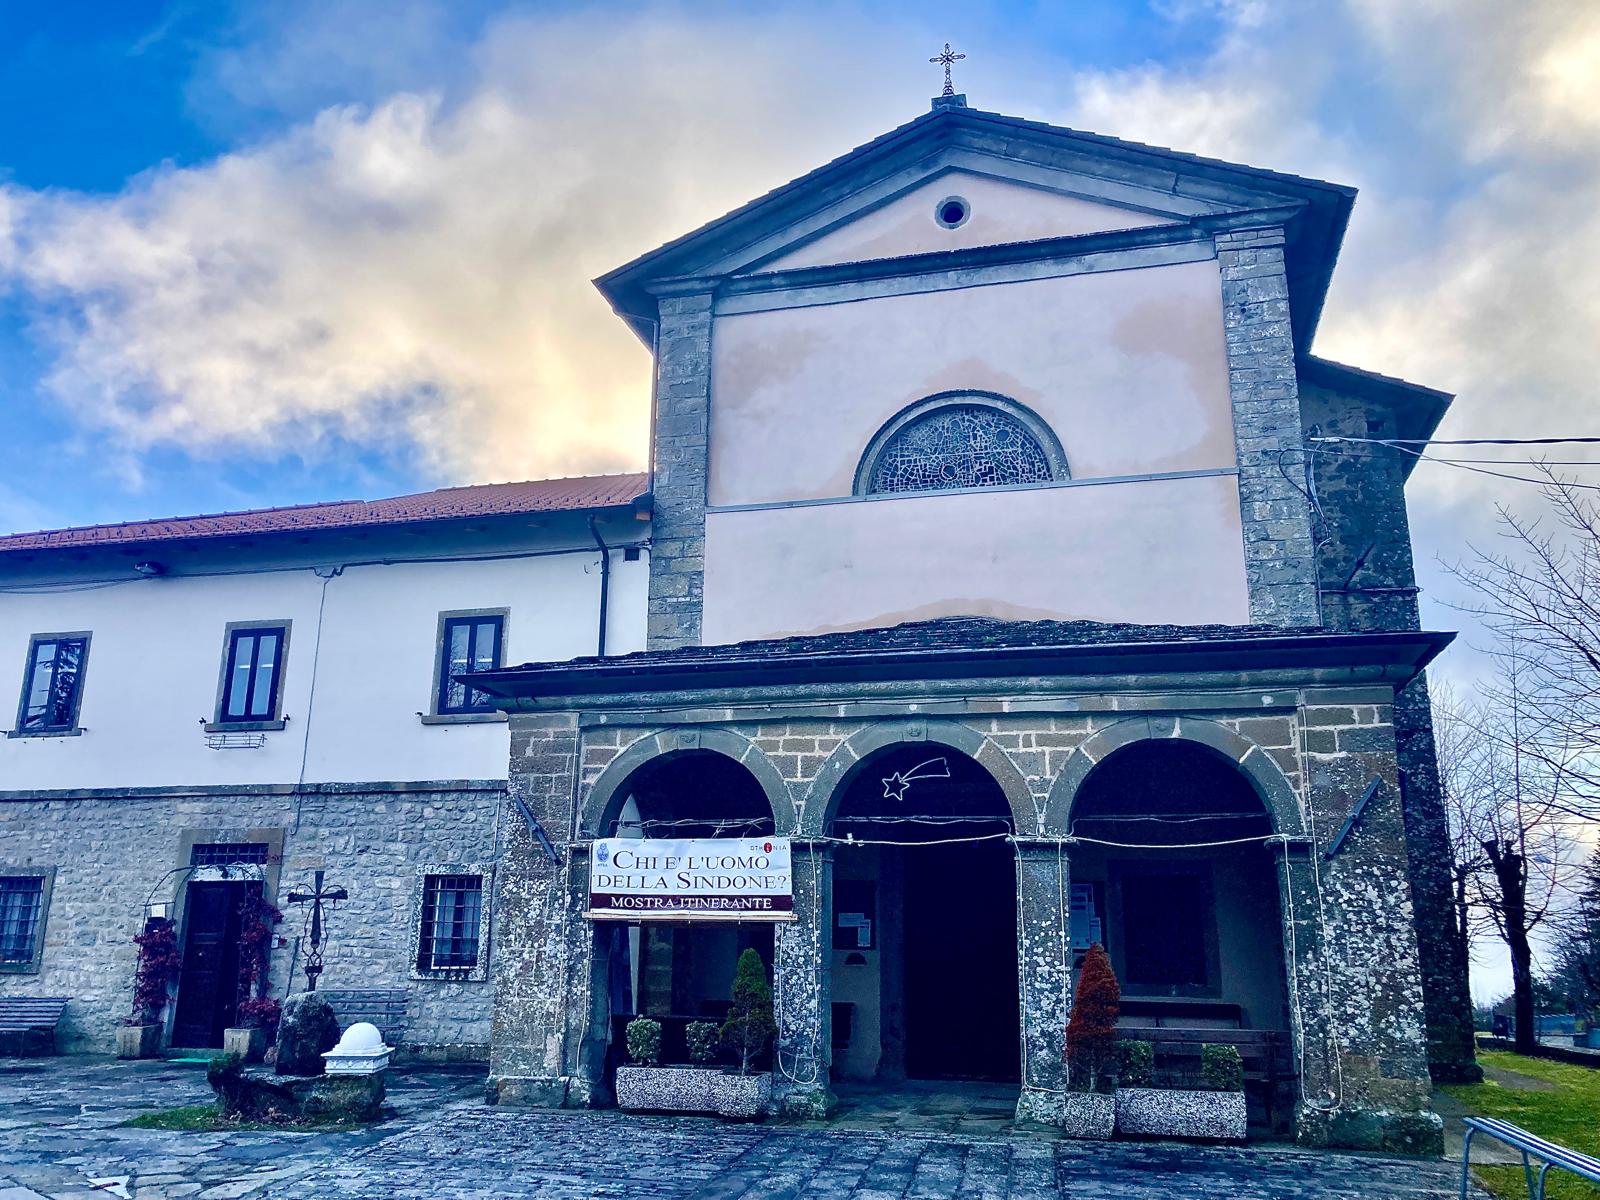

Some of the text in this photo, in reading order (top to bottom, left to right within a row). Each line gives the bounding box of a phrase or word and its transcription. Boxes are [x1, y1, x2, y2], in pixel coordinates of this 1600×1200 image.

[613, 850, 770, 870] CHI E' L'UOMO
[596, 871, 787, 890] DELLA SINDONE?
[611, 896, 772, 909] MOSTRA ITINERANTE
